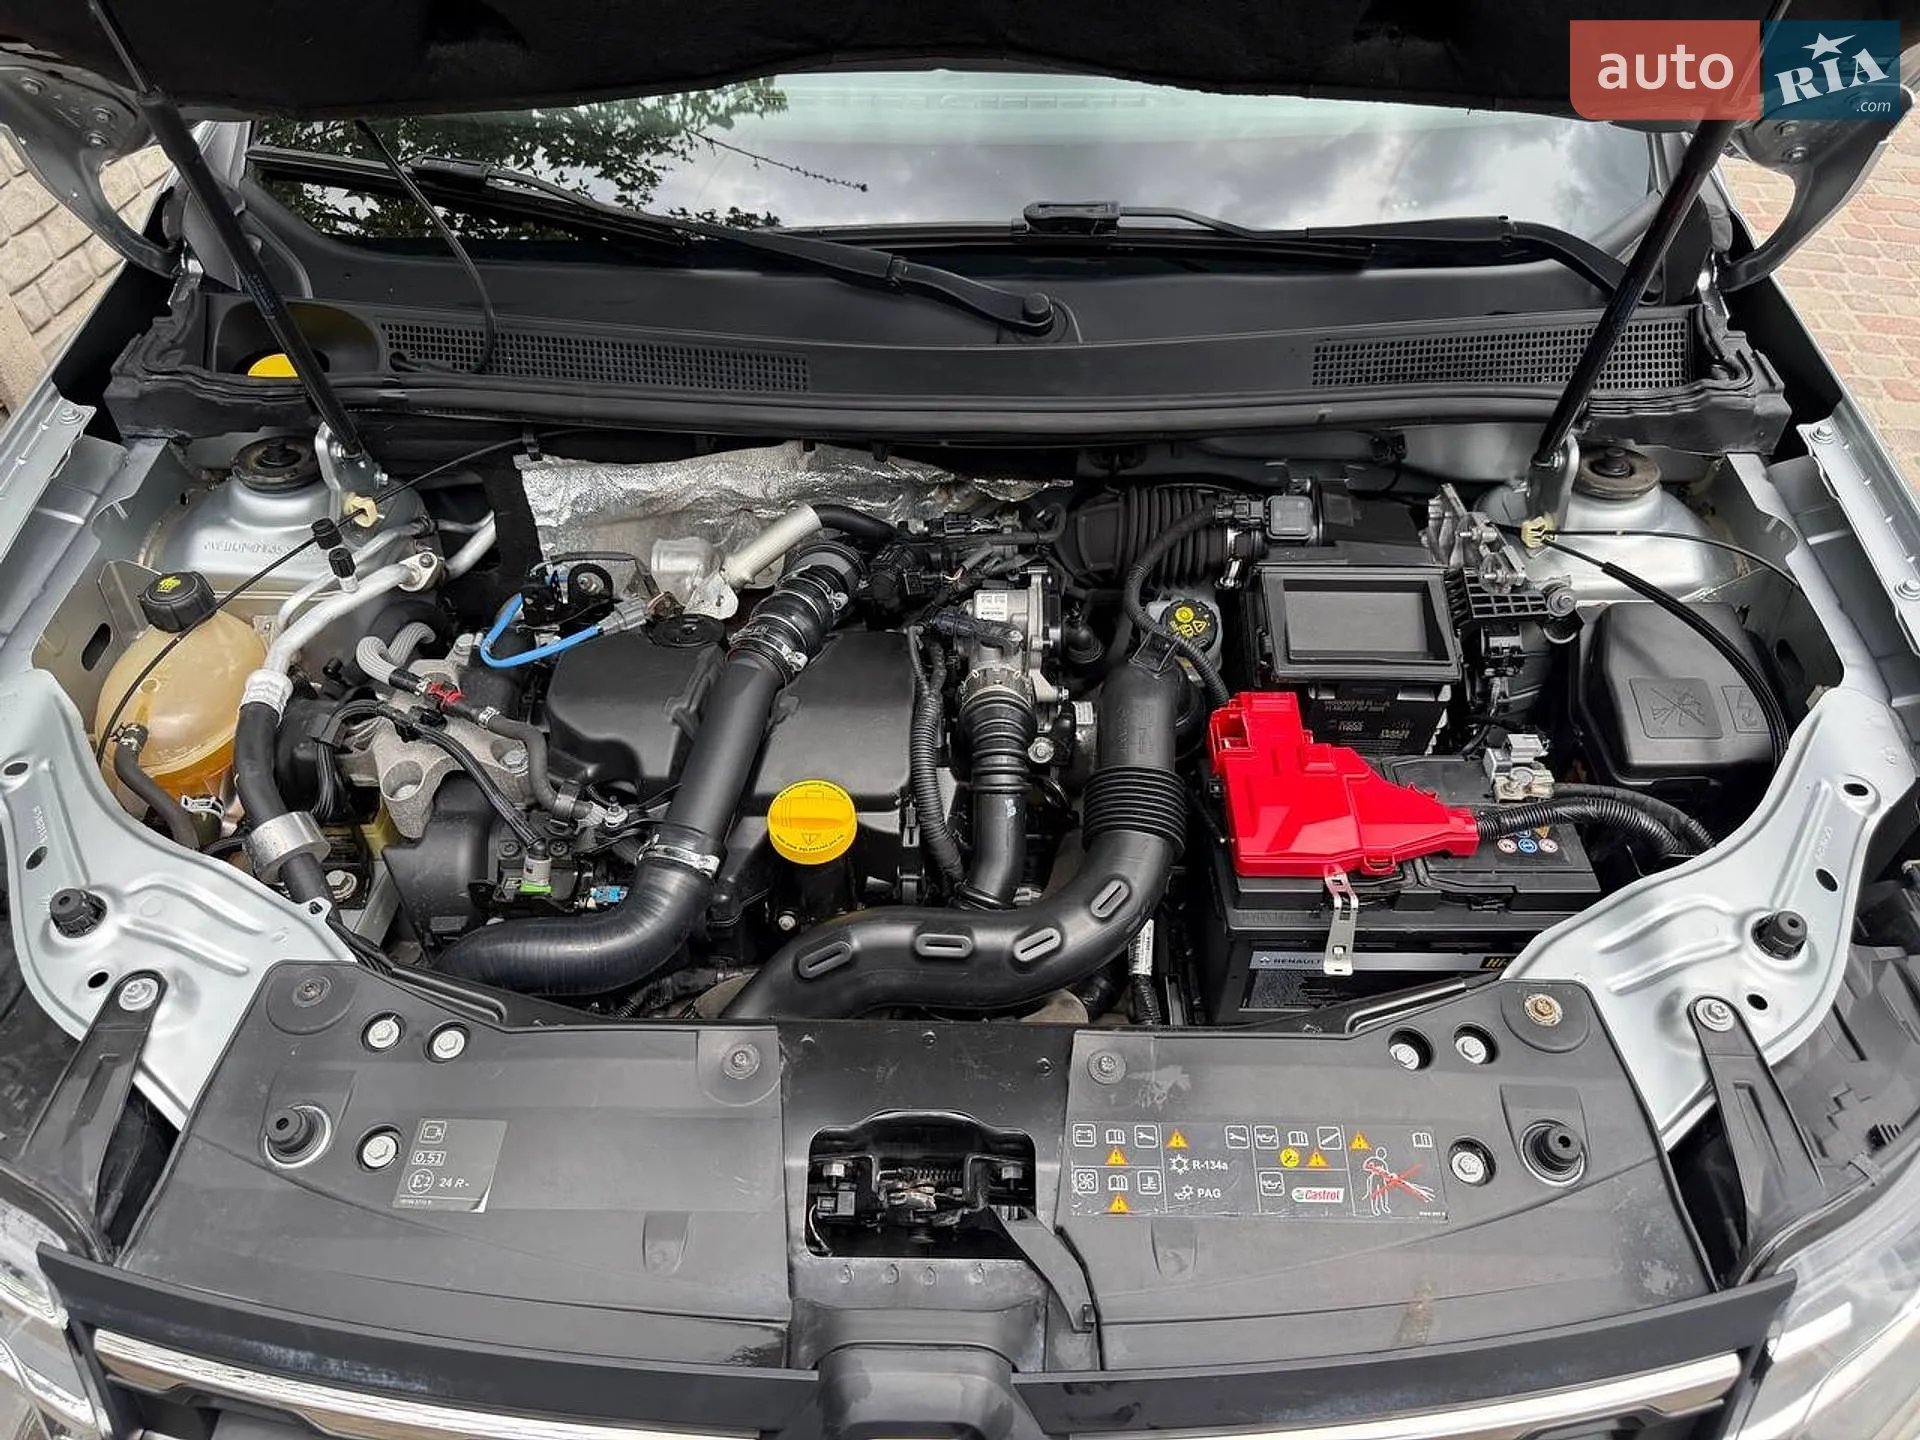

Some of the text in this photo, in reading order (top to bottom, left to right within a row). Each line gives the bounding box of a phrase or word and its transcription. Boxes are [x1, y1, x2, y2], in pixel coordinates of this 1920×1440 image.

[1192, 1159, 1229, 1171] R-134a
[1197, 1188, 1222, 1198] PAG
[1304, 1188, 1342, 1201] Castrol
